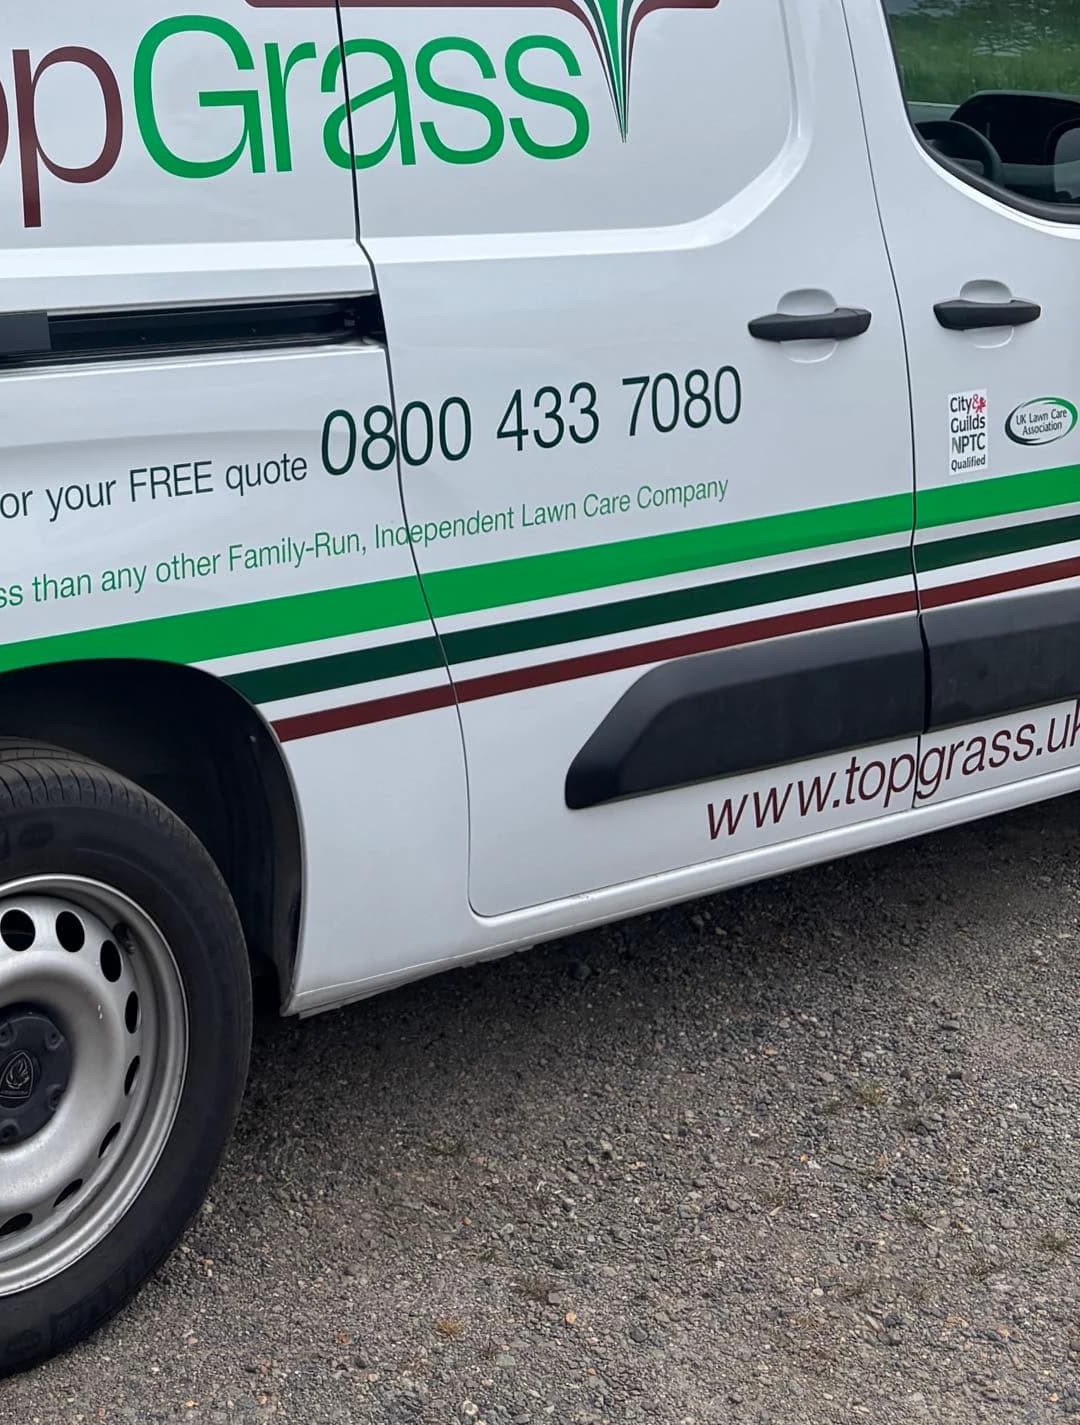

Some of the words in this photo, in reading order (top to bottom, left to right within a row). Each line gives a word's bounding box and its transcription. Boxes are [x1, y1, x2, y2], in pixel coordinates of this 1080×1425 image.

[950, 414, 986, 434] Guilds
[1016, 414, 1027, 426] UK
[1029, 411, 1048, 424] Lawn
[1050, 408, 1068, 419] Care
[1022, 421, 1063, 436] Association
[45, 479, 117, 523] your
[129, 460, 214, 503] FREE
[225, 453, 308, 497] quote
[321, 397, 471, 476] 0800
[496, 381, 600, 452] 433
[622, 365, 742, 437] 7080
[951, 432, 986, 454] NPTC
[951, 454, 986, 472] Qualified
[32, 574, 92, 602] than
[101, 564, 147, 594] any
[155, 552, 221, 583] other
[228, 531, 367, 571] Family-Run,
[375, 507, 515, 549] Independent
[521, 502, 576, 527] Lawn
[583, 494, 631, 518] Care
[637, 479, 729, 509] Company
